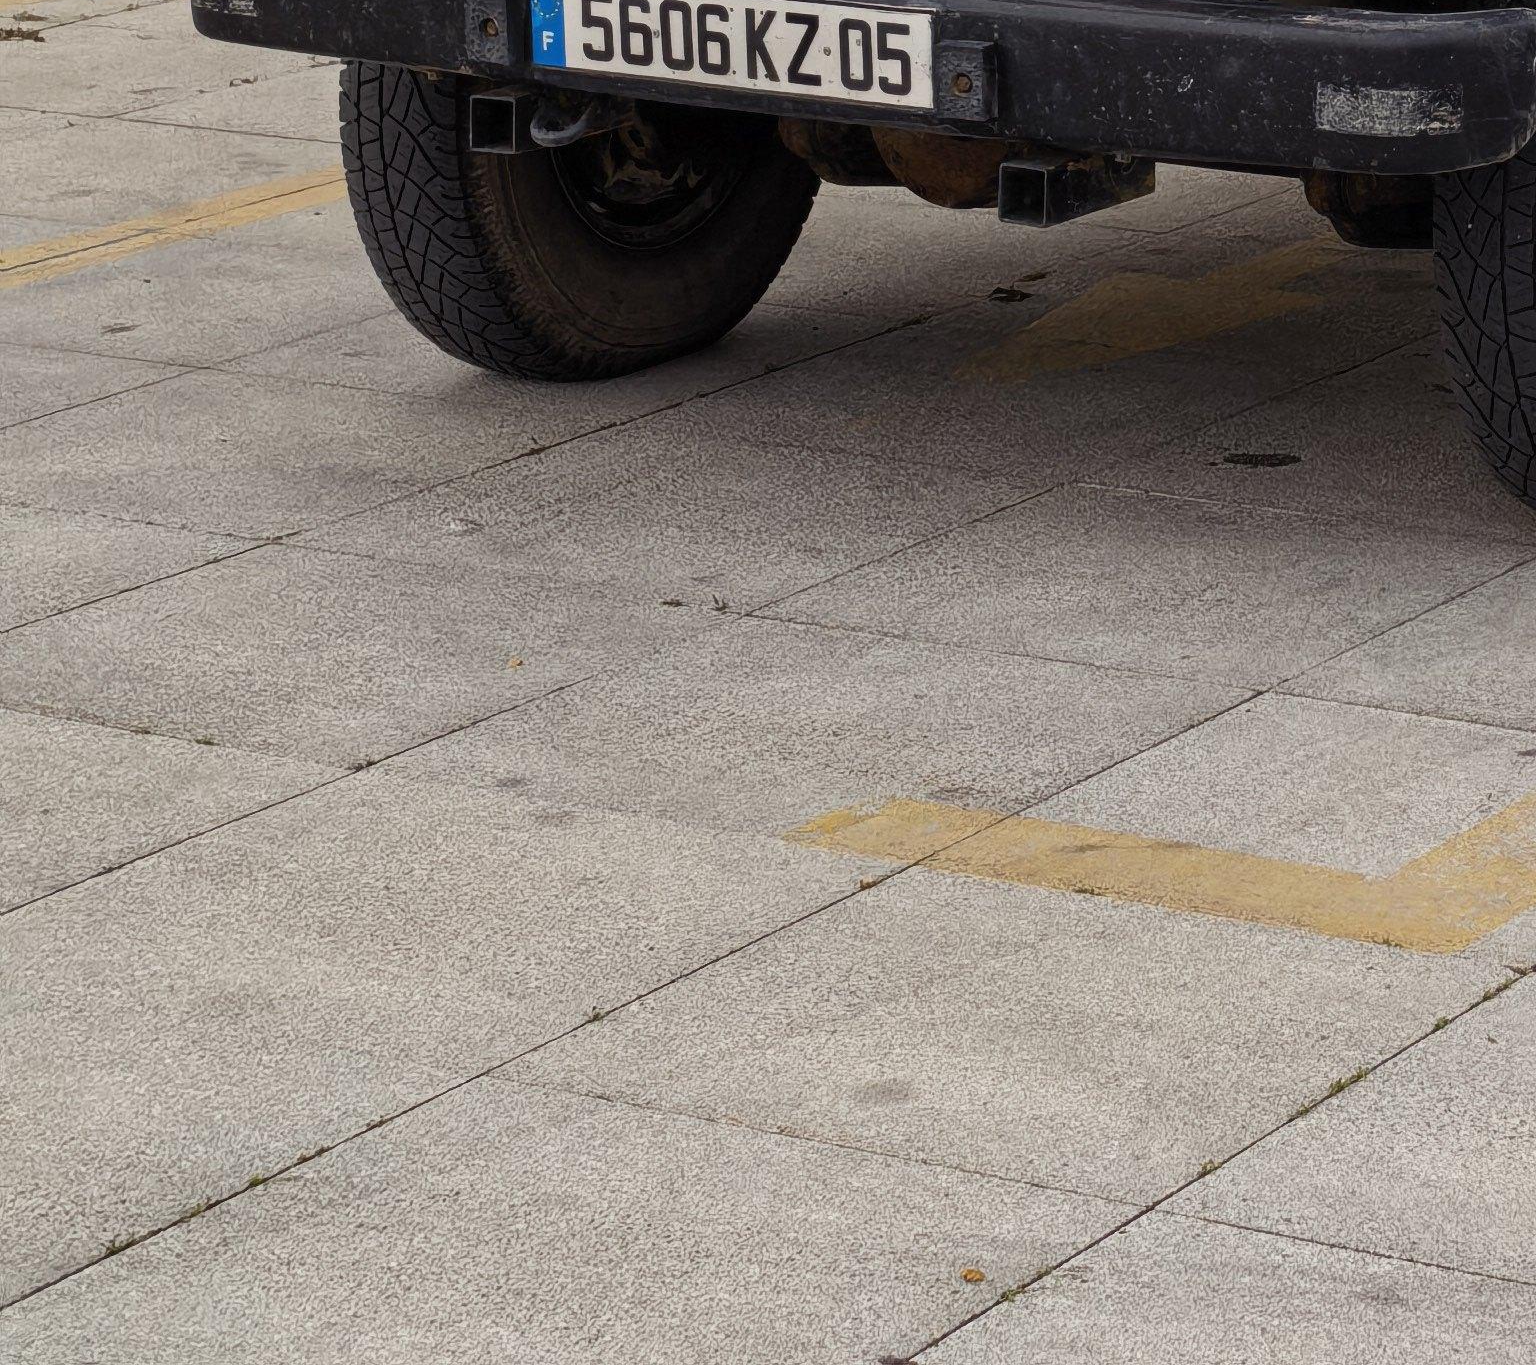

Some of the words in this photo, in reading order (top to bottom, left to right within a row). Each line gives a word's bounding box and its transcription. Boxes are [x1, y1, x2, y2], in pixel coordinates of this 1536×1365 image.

[542, 30, 555, 51] F
[745, 7, 822, 87] KZ
[838, 17, 912, 97] 05
